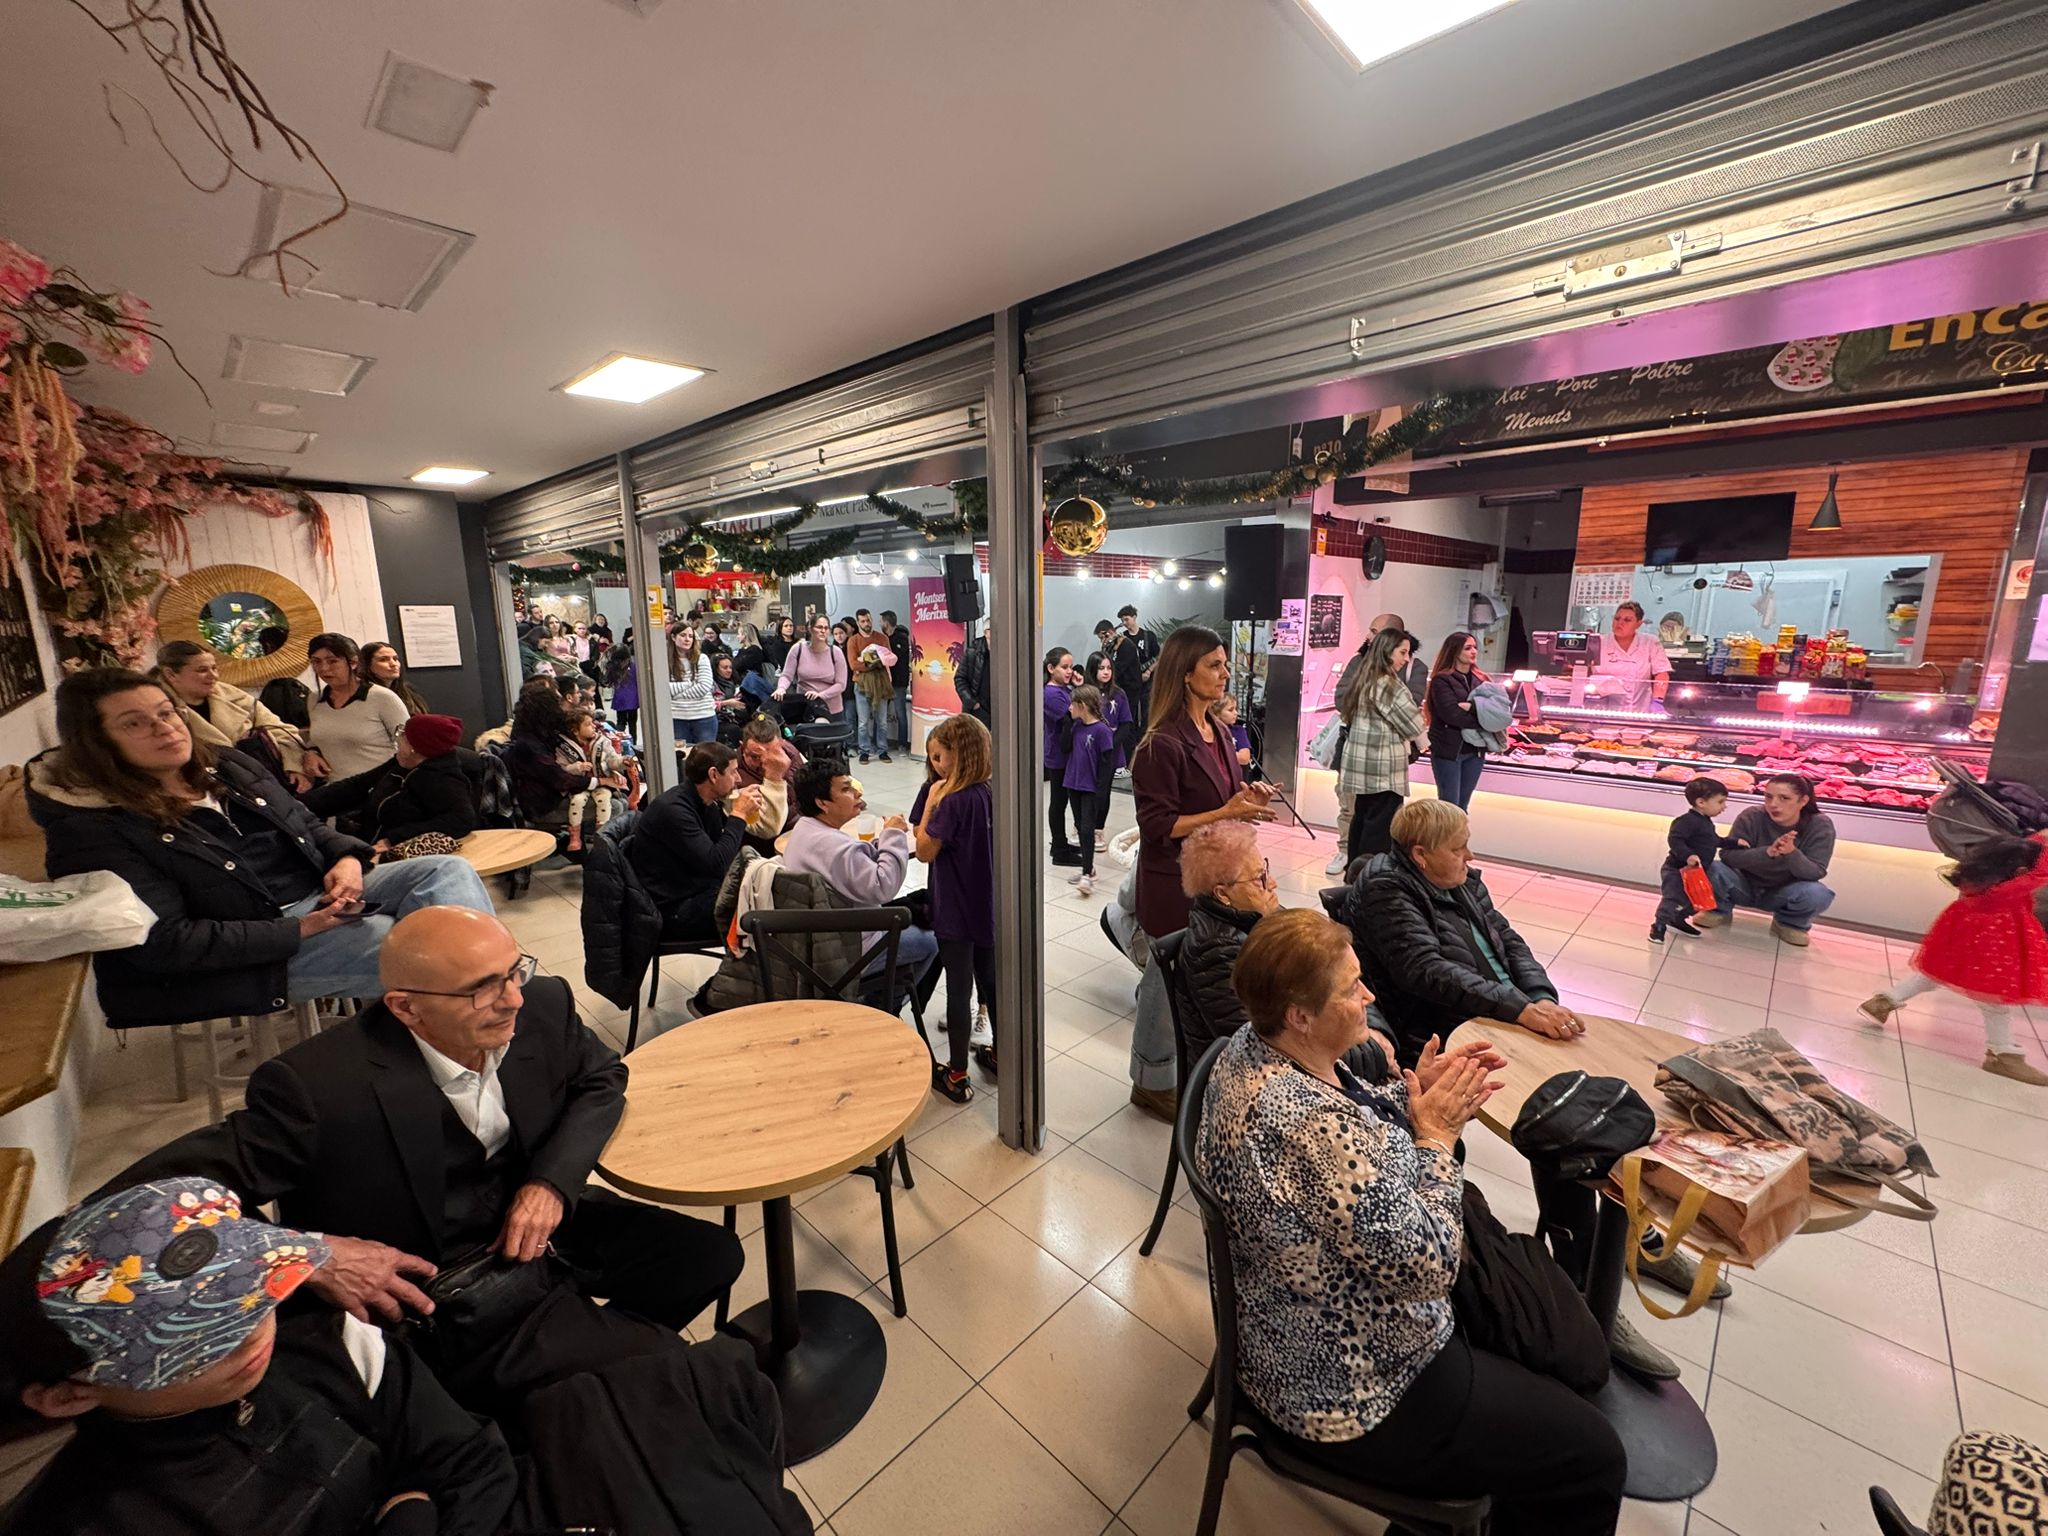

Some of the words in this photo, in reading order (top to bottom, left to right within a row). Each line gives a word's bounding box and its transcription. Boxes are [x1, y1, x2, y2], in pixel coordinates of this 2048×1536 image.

[1555, 377, 1599, 397] Porc
[1629, 361, 1694, 385] Poltre
[1505, 409, 1572, 430] Menuts
